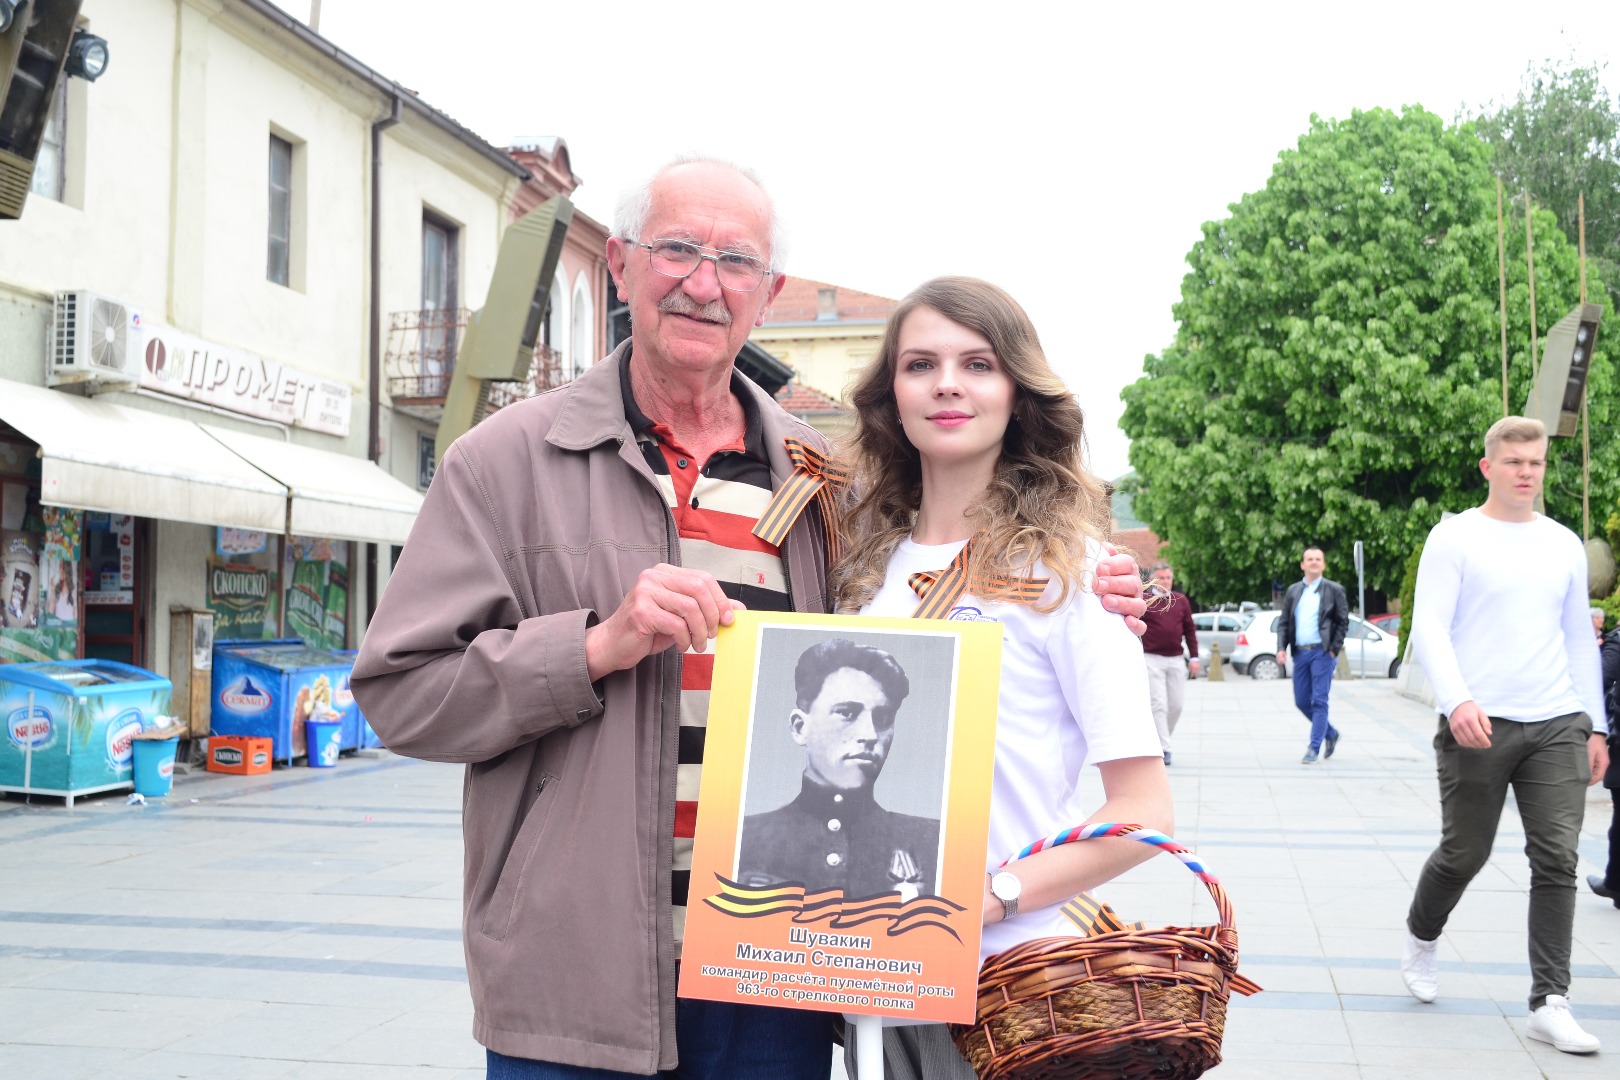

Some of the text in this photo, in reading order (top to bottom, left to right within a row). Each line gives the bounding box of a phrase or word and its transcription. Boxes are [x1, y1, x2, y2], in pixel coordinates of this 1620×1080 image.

[213, 569, 267, 598] СКОПСКО
[789, 928, 871, 949] Шувакин
[736, 943, 923, 974] Михаил Степанович
[701, 965, 955, 998] командир расчёта пулемётной роты
[737, 982, 915, 1010] 963-го стрелкового полка
